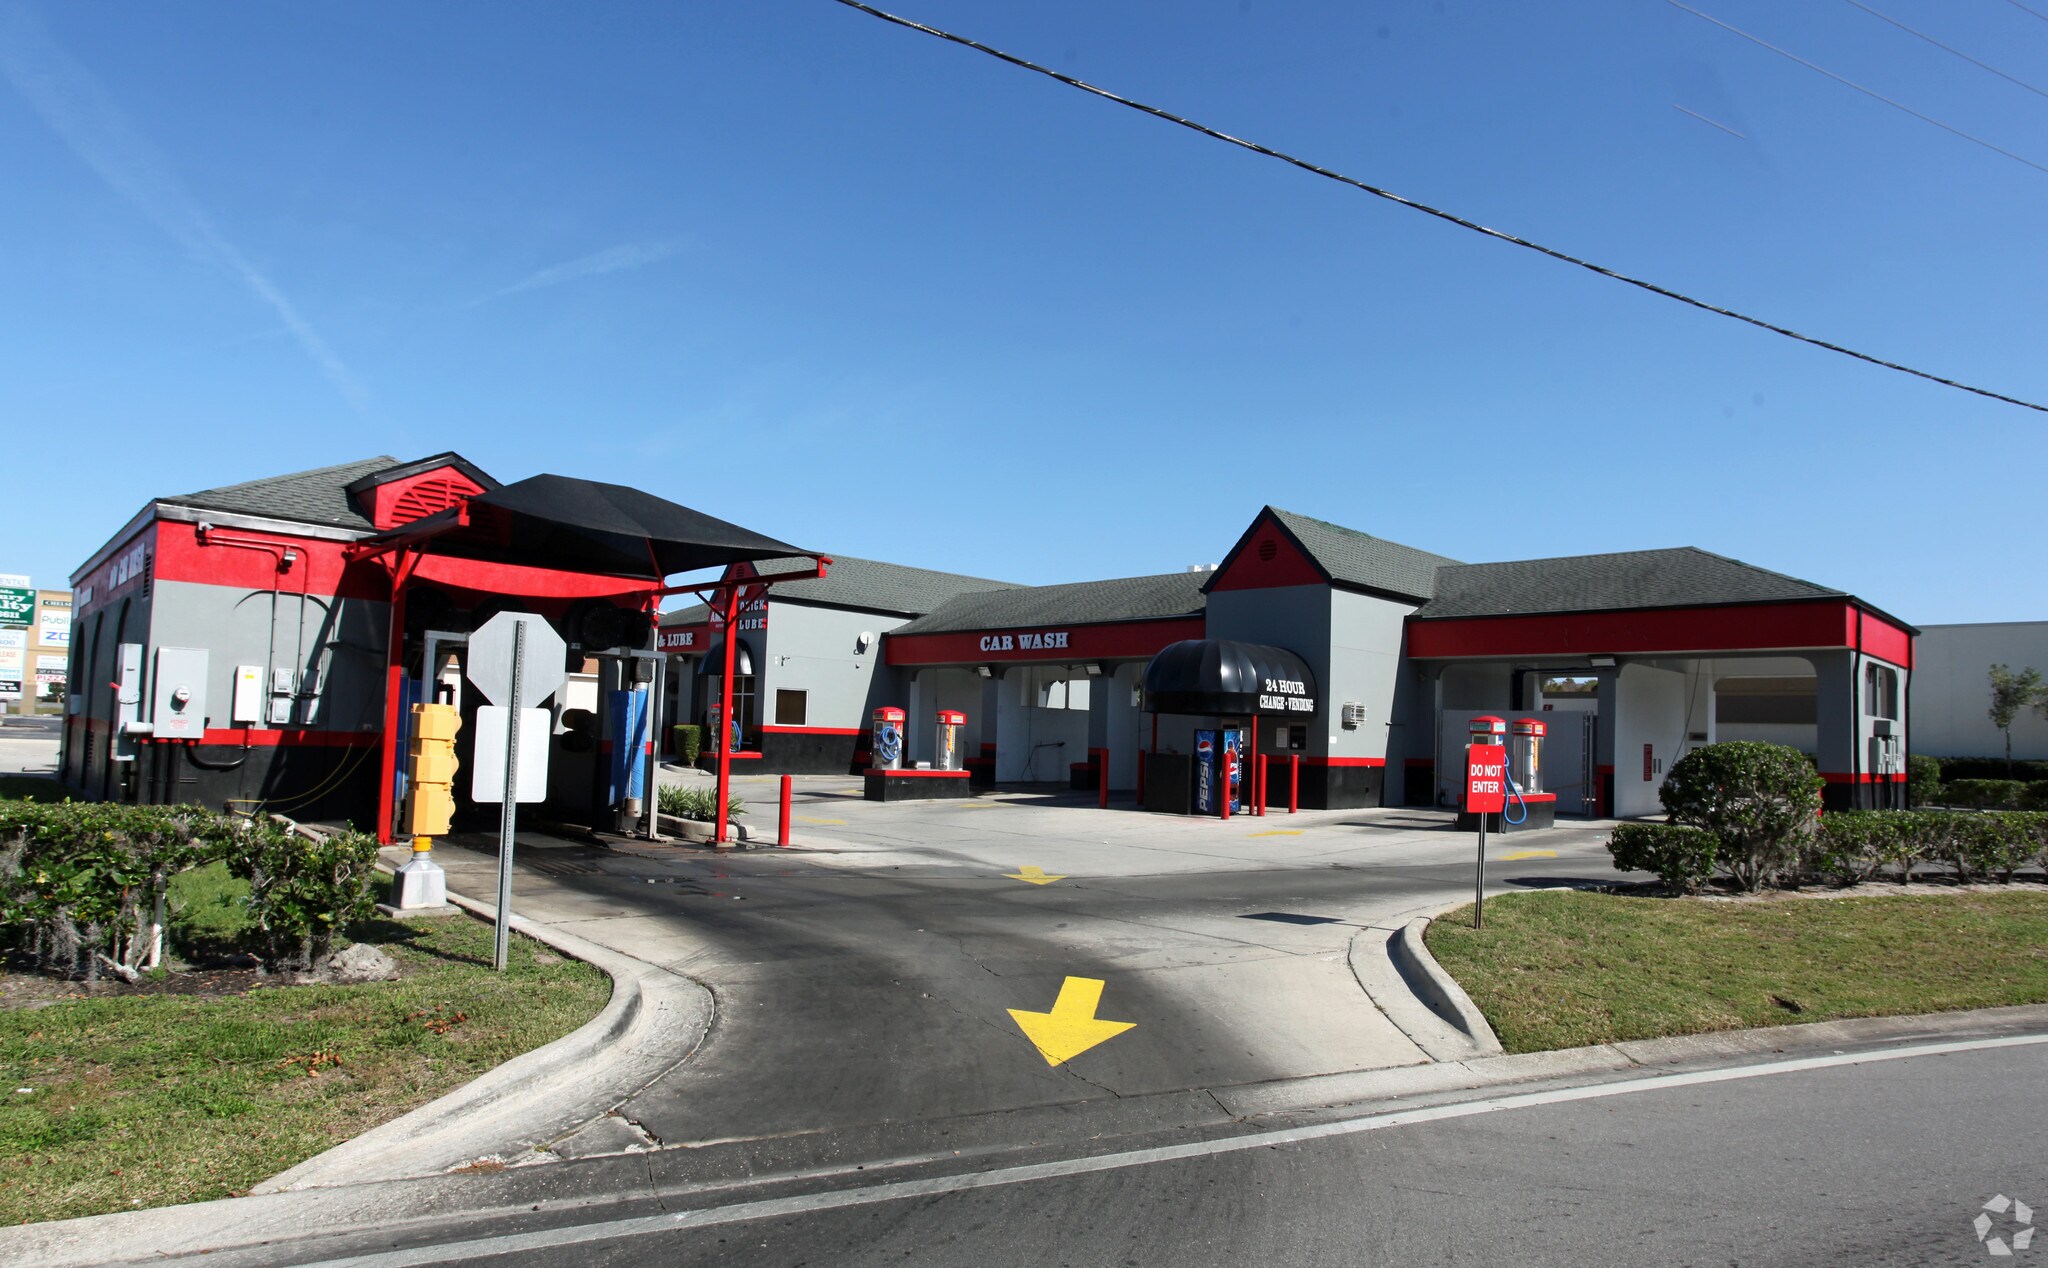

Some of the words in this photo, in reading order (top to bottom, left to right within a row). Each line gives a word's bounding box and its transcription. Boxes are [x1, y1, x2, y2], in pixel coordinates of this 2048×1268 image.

[739, 618, 763, 630] LUBE
[658, 634, 666, 648] &
[667, 632, 693, 647] LUBE
[980, 635, 1014, 652] CAR
[1018, 632, 1069, 650] WASH
[1265, 679, 1278, 692] 24
[1278, 680, 1305, 695] HOUR
[1259, 694, 1285, 710] CHANGE
[1288, 697, 1314, 712] VENDING
[1470, 764, 1483, 777] DO
[1484, 764, 1502, 777] NOT
[1200, 761, 1209, 812] PEPSI
[1472, 781, 1499, 793] ENTER
